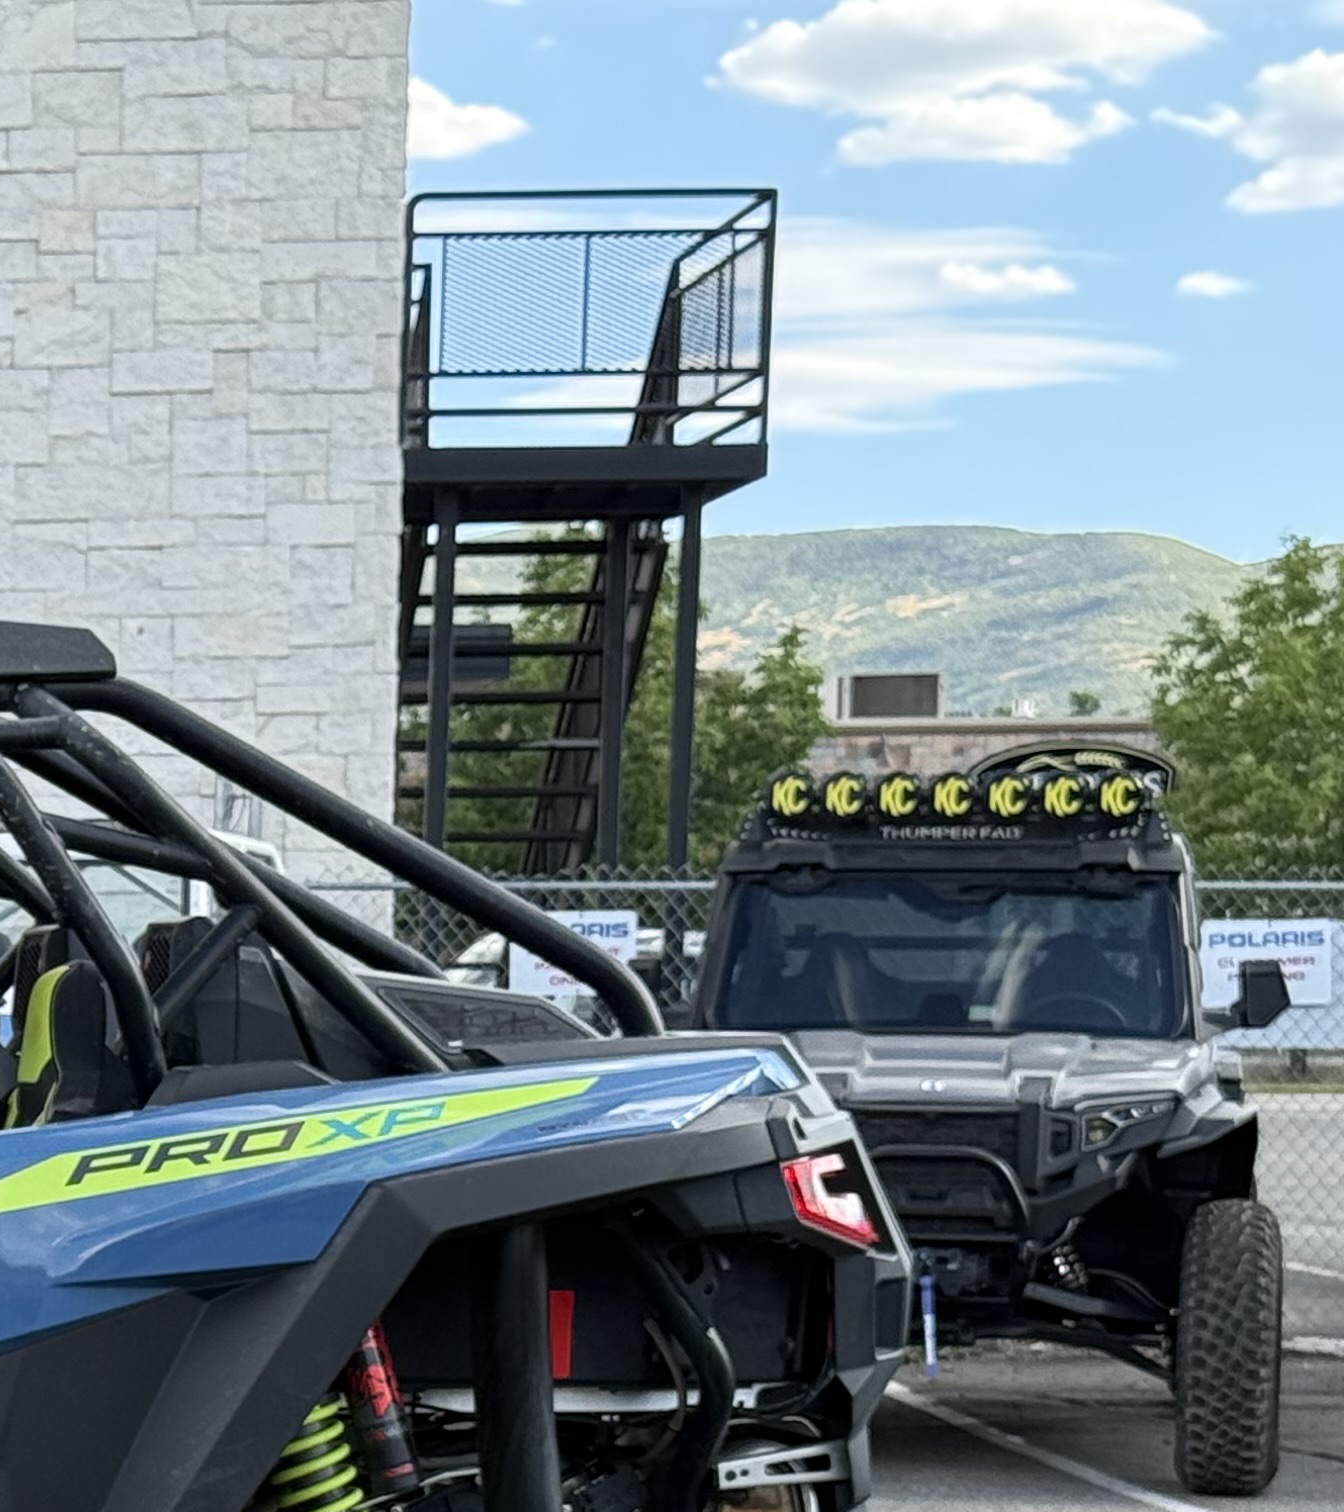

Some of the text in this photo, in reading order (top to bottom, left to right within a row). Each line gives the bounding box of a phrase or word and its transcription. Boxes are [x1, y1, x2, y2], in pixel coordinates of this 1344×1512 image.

[771, 777, 806, 816] KC
[825, 777, 862, 816] KC
[879, 777, 914, 816] KC
[933, 777, 970, 816] KC
[988, 777, 1025, 816] KC
[1043, 777, 1080, 816] KC
[1099, 777, 1138, 816] KC
[1208, 929, 1325, 948] POLARIS
[64, 1101, 447, 1187] PRO XP
